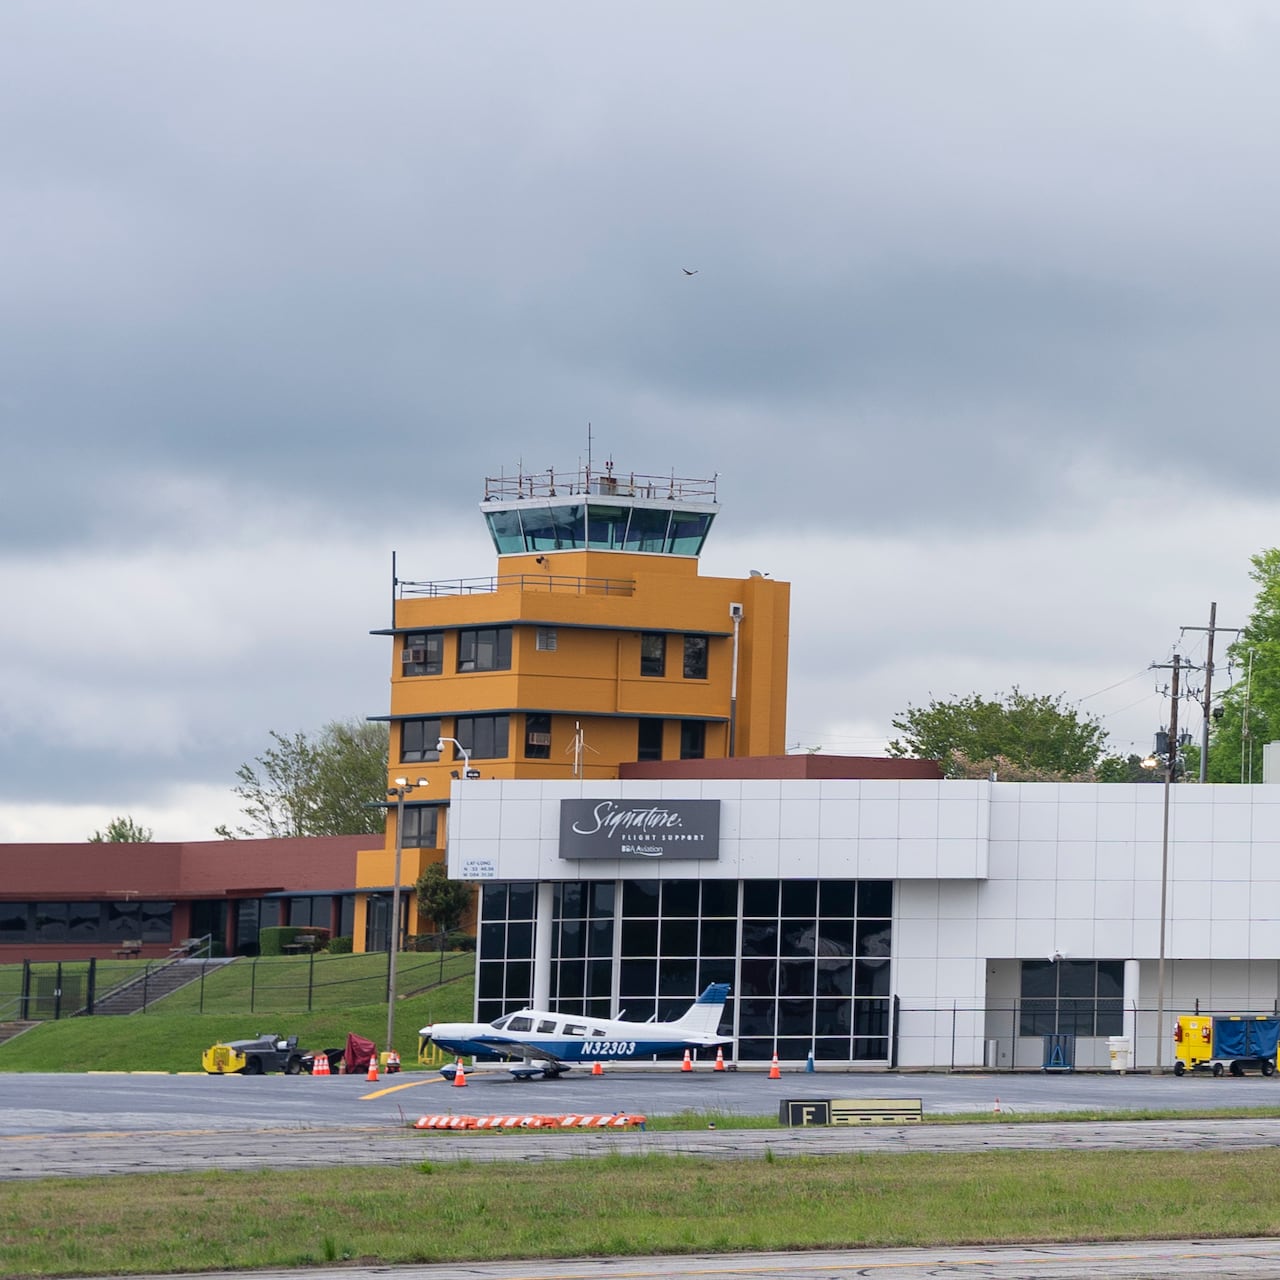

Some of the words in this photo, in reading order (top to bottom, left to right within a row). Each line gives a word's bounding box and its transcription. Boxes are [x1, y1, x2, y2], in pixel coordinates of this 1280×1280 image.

[636, 845, 663, 855] Aviation
[581, 1042, 636, 1055] N32303
[803, 1107, 816, 1126] F
